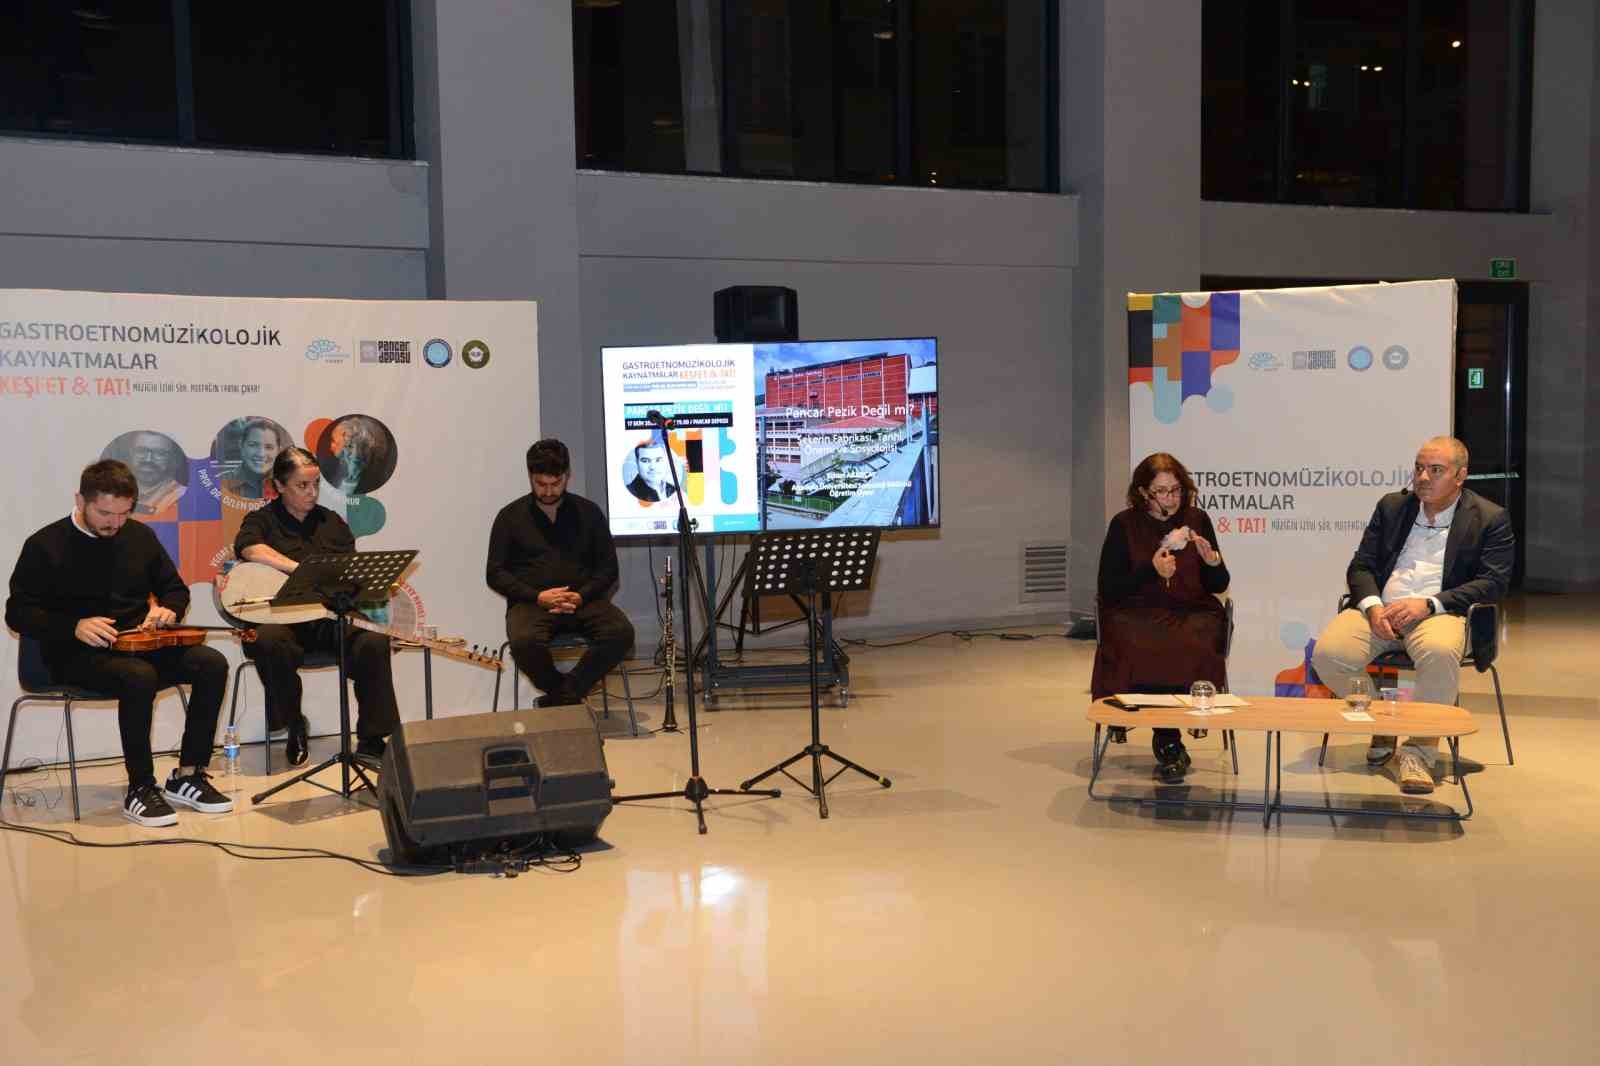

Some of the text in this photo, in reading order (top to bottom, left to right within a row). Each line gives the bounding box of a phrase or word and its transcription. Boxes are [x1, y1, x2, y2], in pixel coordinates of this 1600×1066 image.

[0, 322, 281, 346] GASTROETNOMÜZİKOLOJİK
[0, 350, 158, 370] KAYNATMALAR
[785, 407, 824, 418] Pancar
[828, 405, 857, 417] Pezik
[895, 404, 915, 416] mi?
[1216, 516, 1233, 534] &
[1236, 517, 1266, 533] TAT!
